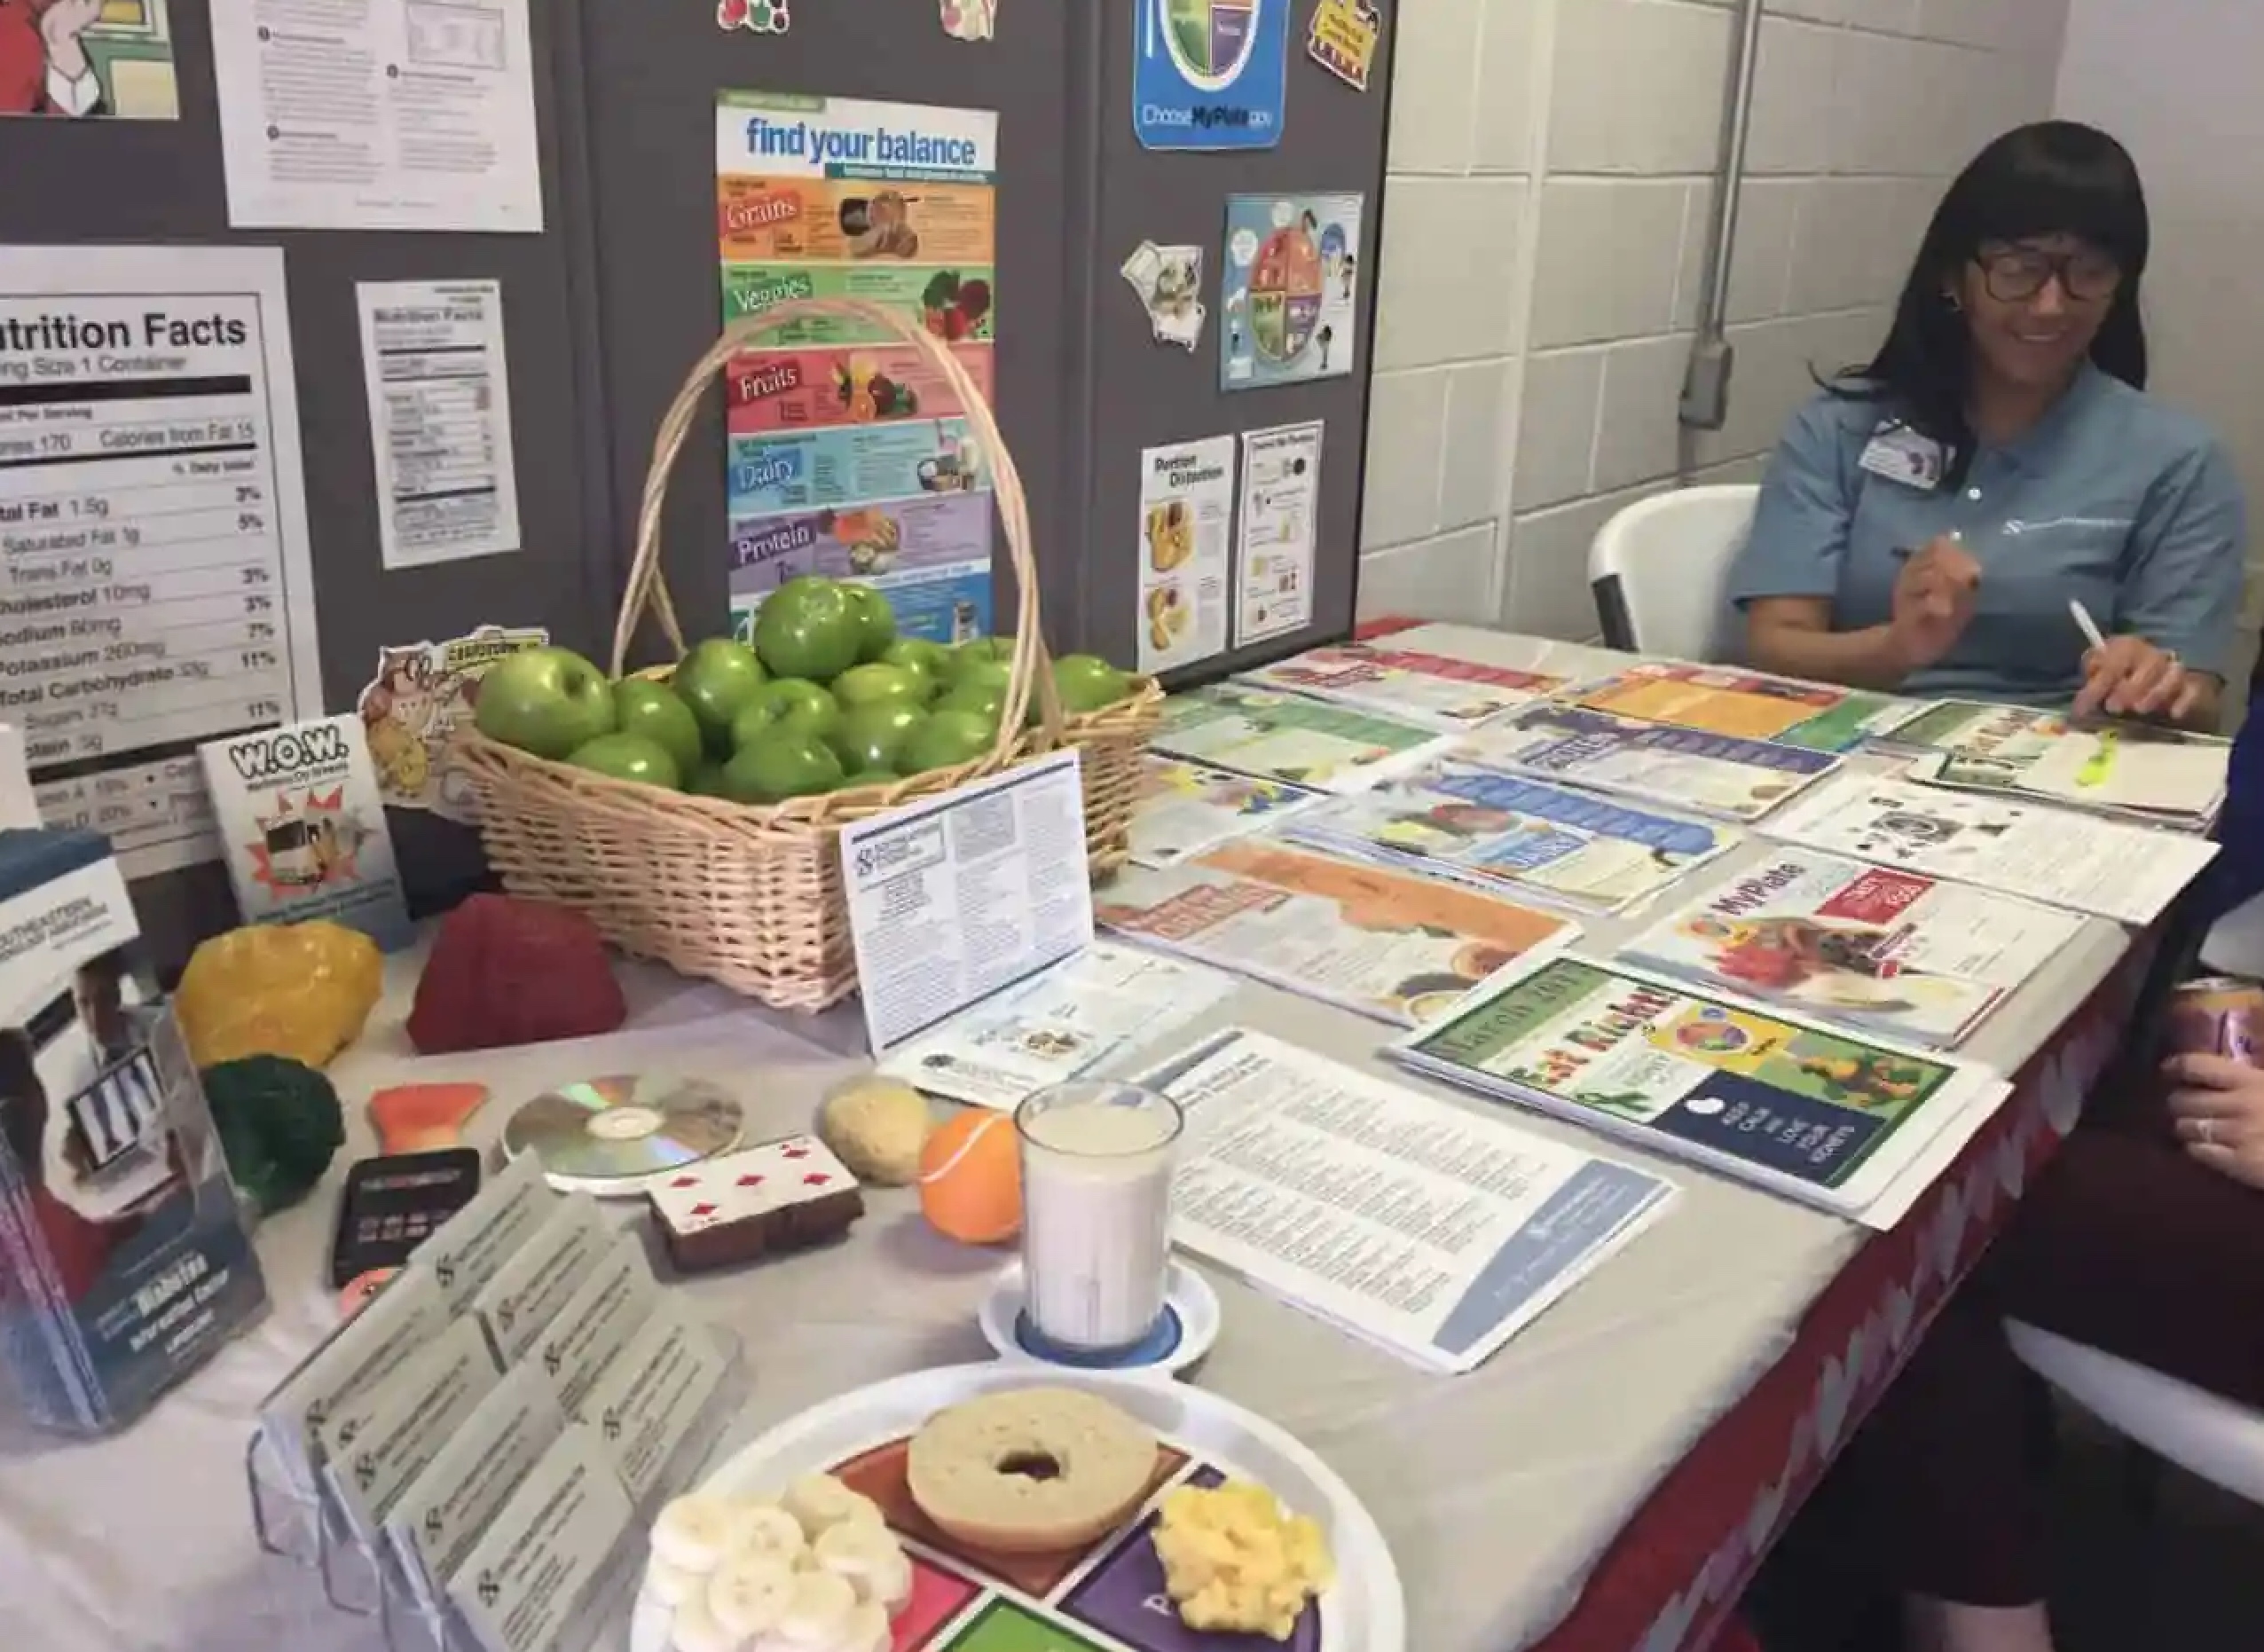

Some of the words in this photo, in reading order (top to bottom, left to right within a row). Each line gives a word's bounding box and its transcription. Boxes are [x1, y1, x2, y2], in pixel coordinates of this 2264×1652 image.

[746, 116, 806, 155] find
[808, 127, 875, 164] your
[876, 127, 976, 166] balance
[724, 192, 798, 229] Grains
[0, 314, 131, 350] trition
[144, 311, 248, 348] Facts
[33, 357, 75, 377] Size
[82, 356, 91, 372] 1
[98, 353, 187, 374] Container
[738, 366, 798, 401] Fruits
[41, 434, 72, 451] 170
[99, 428, 164, 448] Calories
[0, 503, 22, 521] tal
[28, 501, 59, 519] Fat
[736, 523, 811, 564] Protein
[0, 586, 97, 614] holesterol
[0, 624, 66, 647] odium
[229, 723, 350, 780] W.O.W.
[1709, 862, 1806, 916] MyPlate
